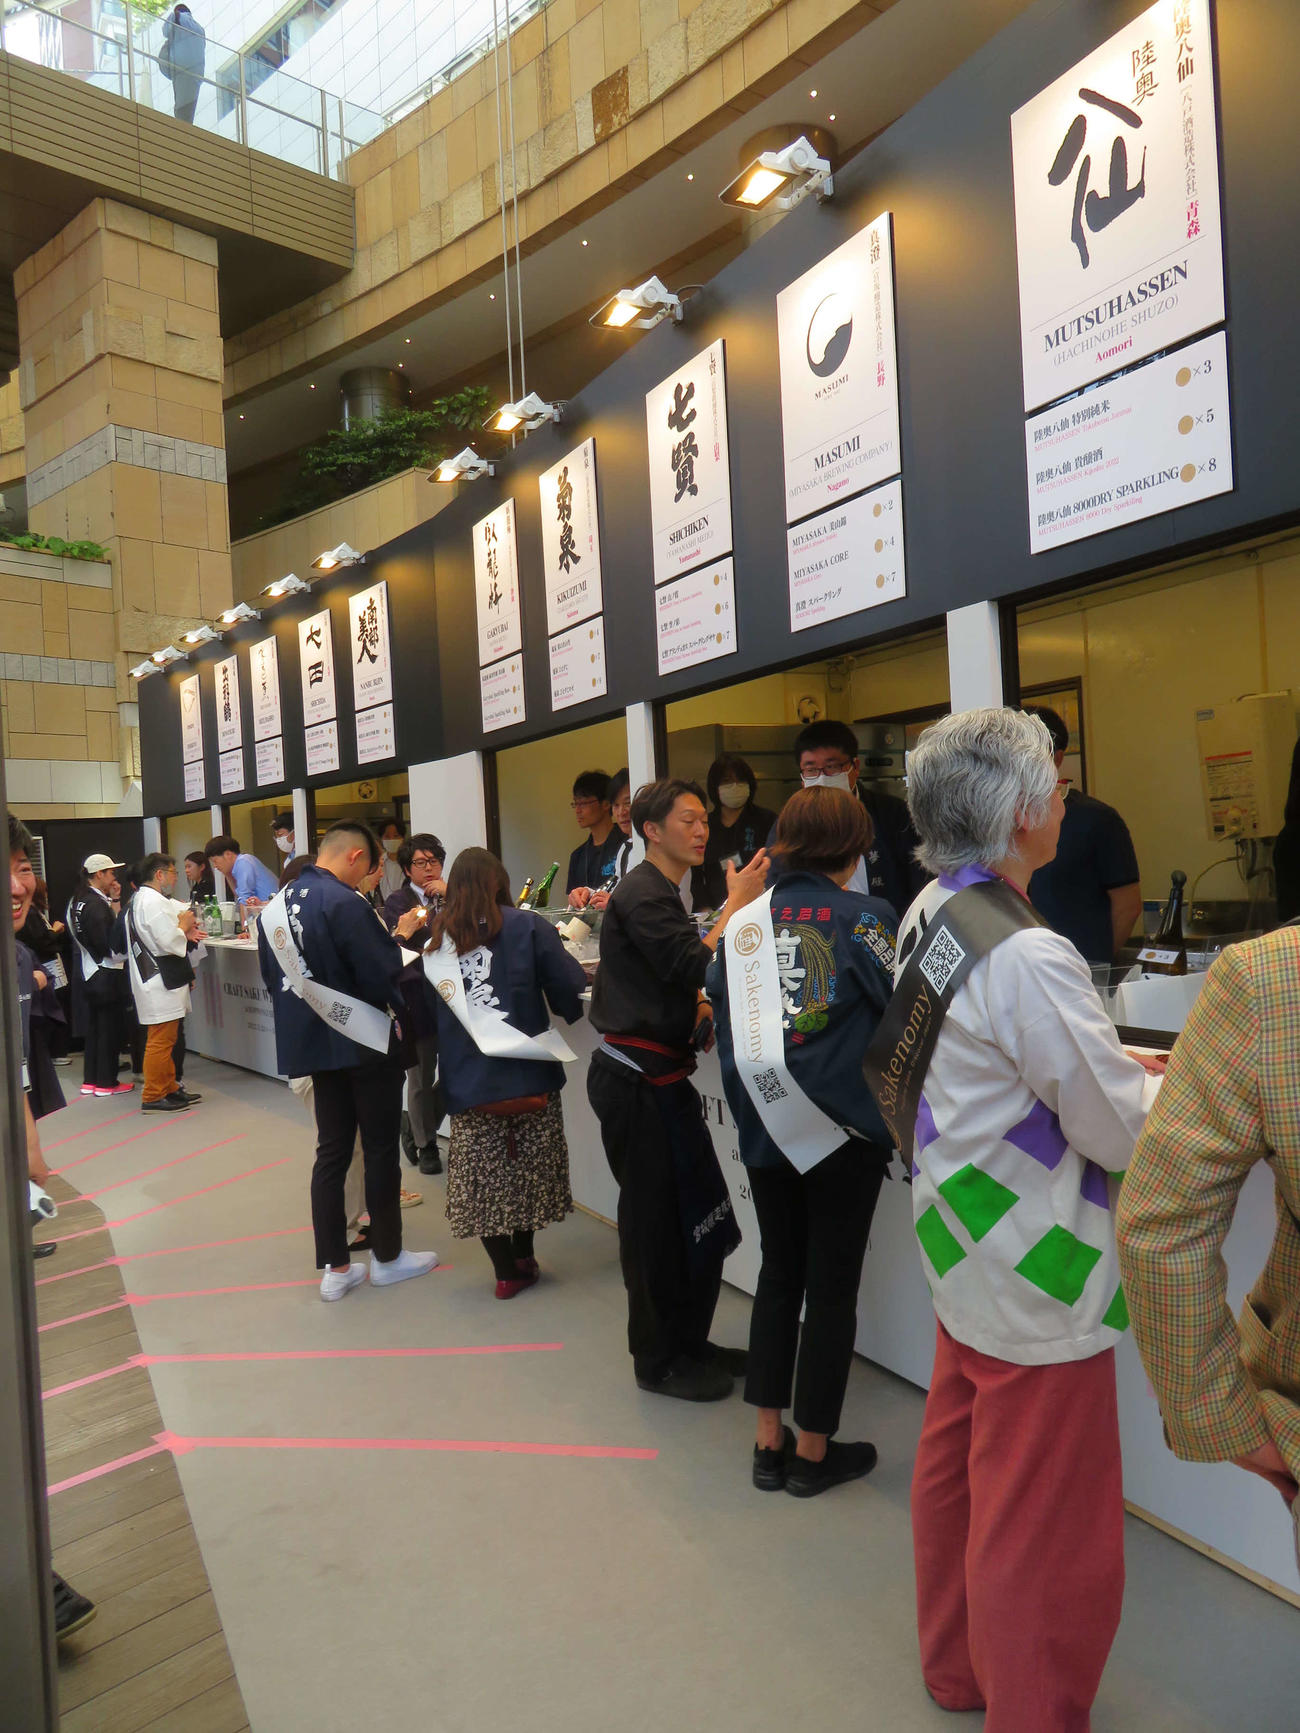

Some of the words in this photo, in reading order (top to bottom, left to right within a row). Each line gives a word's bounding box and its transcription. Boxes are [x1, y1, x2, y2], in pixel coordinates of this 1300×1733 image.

[1131, 40, 1159, 106] 陸奥
[1043, 260, 1189, 353] MUTSUHASSEN
[1053, 317, 1128, 366] (HACHINOHE
[1131, 295, 1179, 328] SHUZO)
[1095, 336, 1133, 363] Aomori
[814, 373, 849, 400] MASUMI
[668, 382, 699, 503] 七賢
[813, 434, 861, 471] MASUMI
[823, 458, 854, 482] BREWING
[827, 475, 849, 493] Nagano
[1116, 465, 1179, 499] SPARKLING
[669, 514, 708, 545] SHICHIKEN
[792, 524, 826, 547] MIYASAKA
[793, 558, 828, 579] MIYASAKA
[830, 550, 848, 565] CORE
[744, 960, 763, 1064] Sakenomy
[879, 983, 932, 1117] Sakenomy
